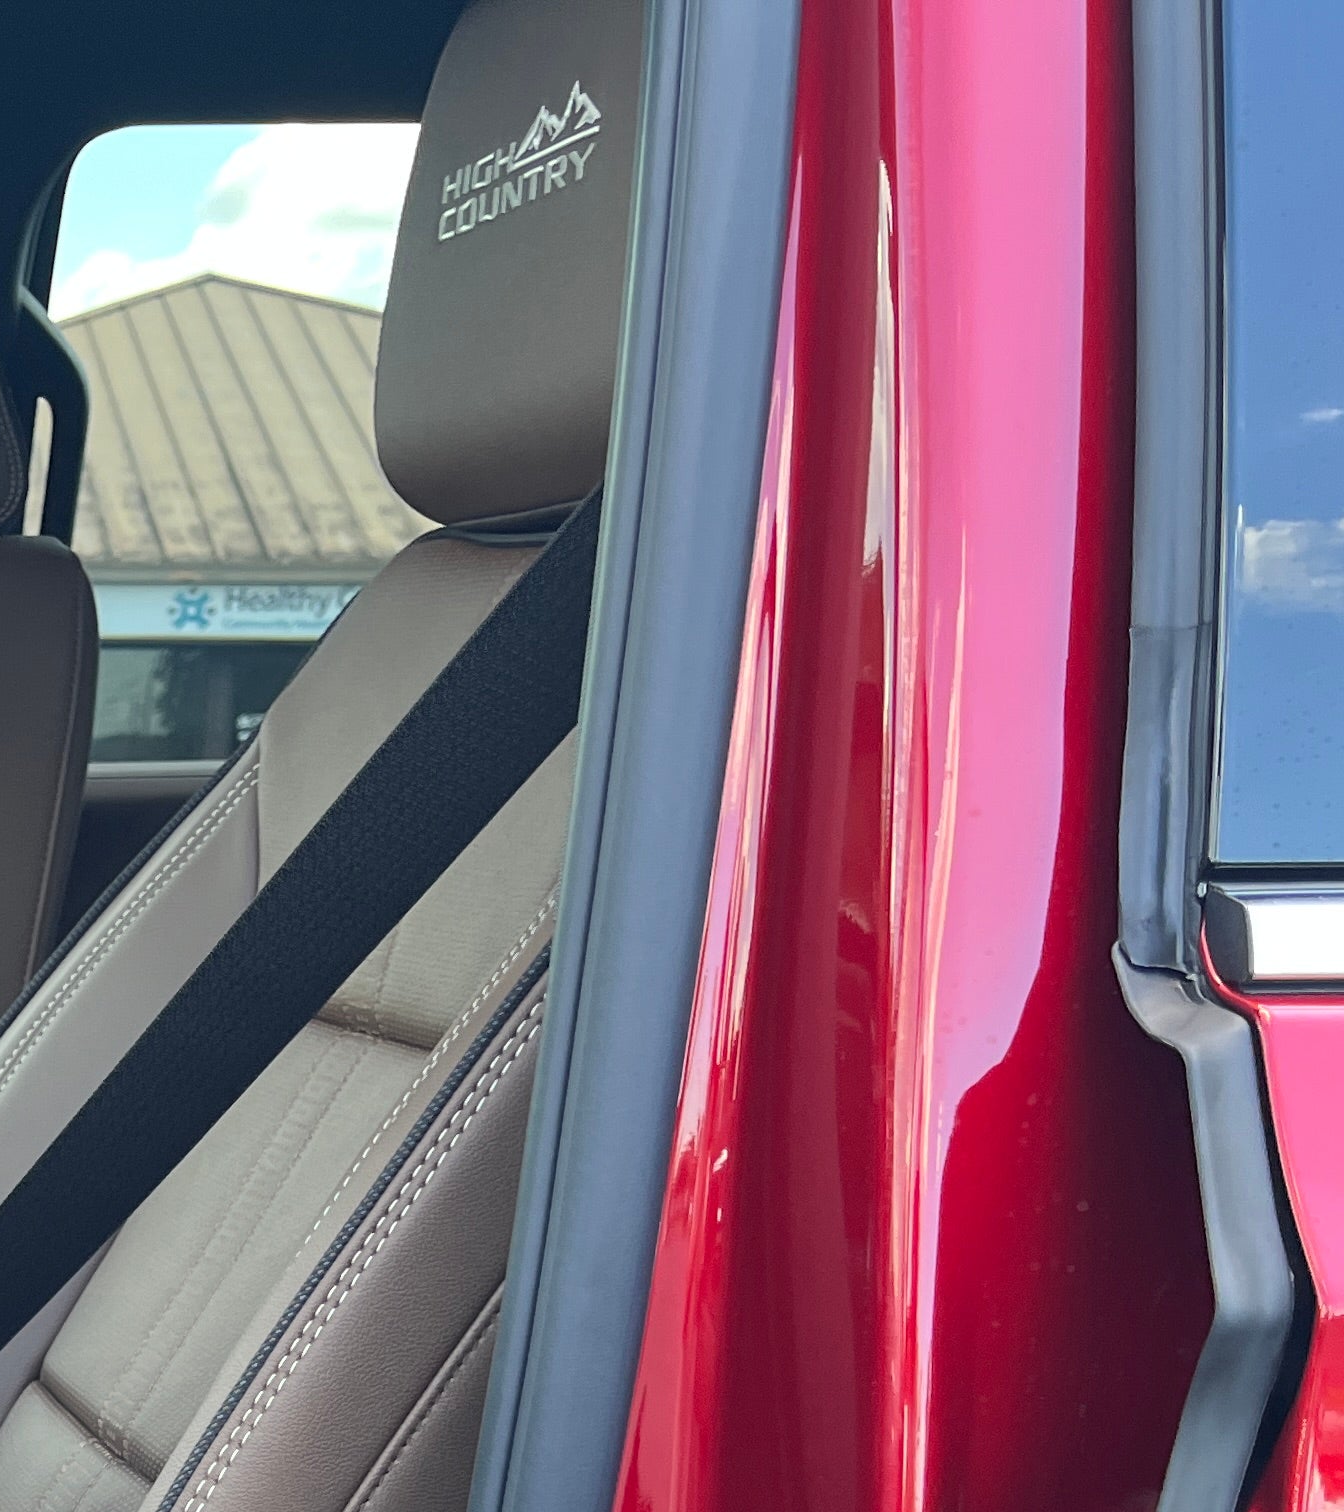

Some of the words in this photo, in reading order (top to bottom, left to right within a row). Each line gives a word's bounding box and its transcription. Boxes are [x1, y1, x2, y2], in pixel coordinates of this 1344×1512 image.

[438, 142, 596, 242] COUNTRY
[441, 141, 517, 205] HIGH
[223, 586, 328, 618] Healthy
